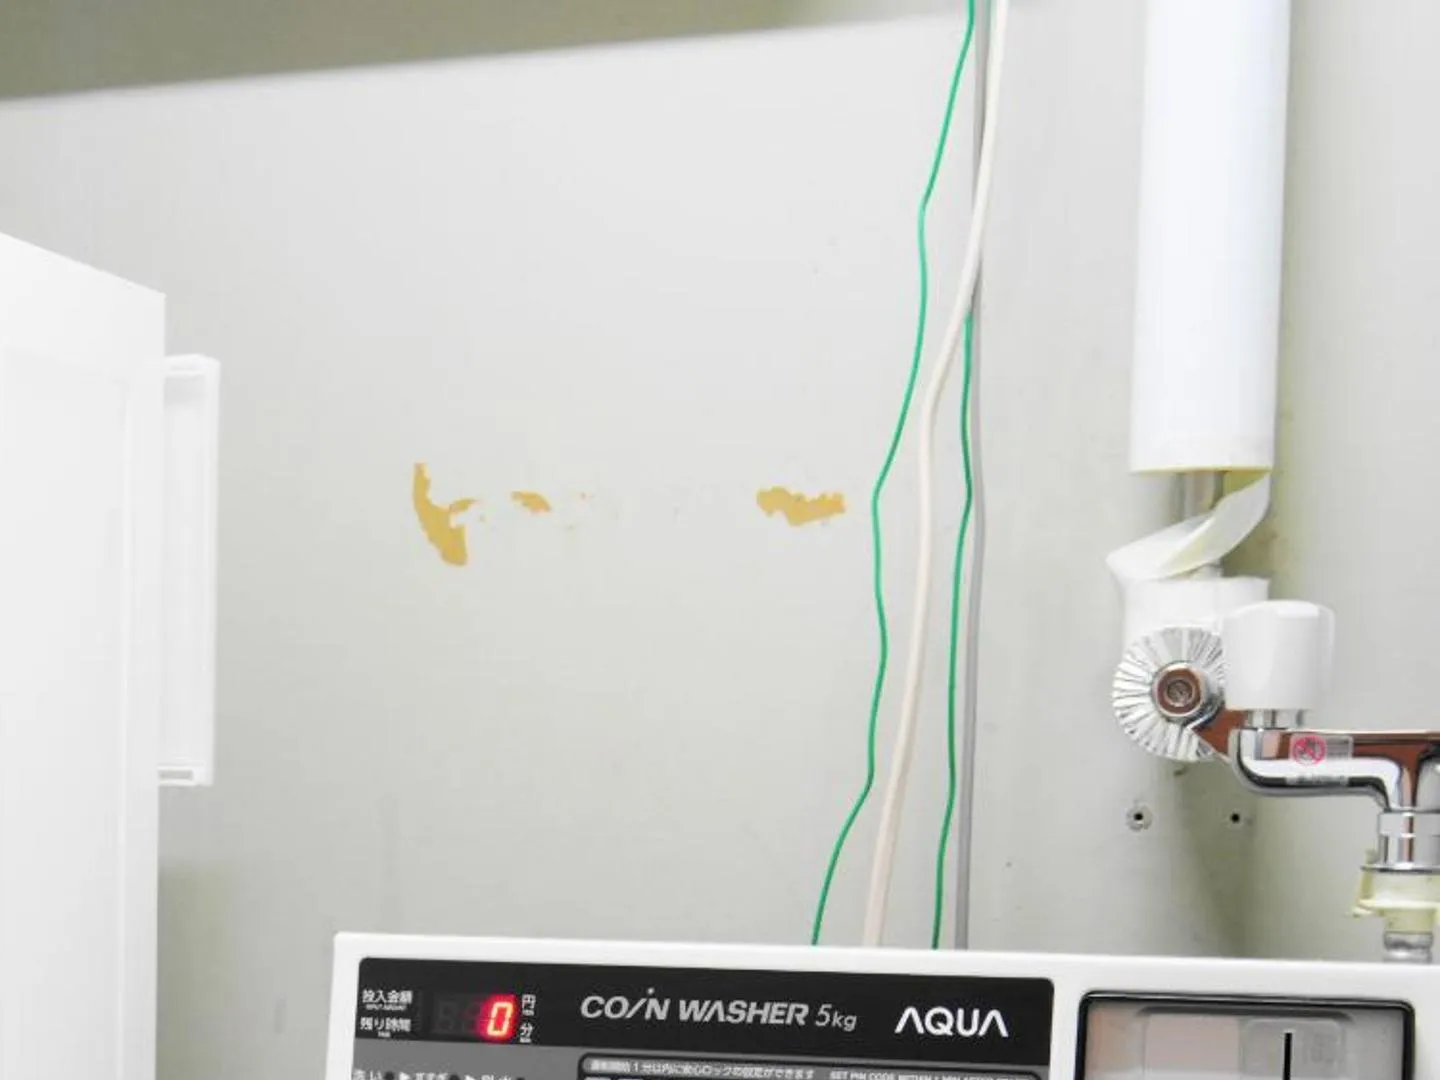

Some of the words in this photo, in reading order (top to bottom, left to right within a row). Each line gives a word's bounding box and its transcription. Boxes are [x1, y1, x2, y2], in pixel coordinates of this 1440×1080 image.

[487, 1001, 514, 1037] 0
[580, 987, 670, 1020] COIN
[678, 1000, 809, 1026] WASHER
[815, 1004, 857, 1032] 5kg
[894, 1006, 1009, 1037] AQUA
[520, 1022, 533, 1037] 分
